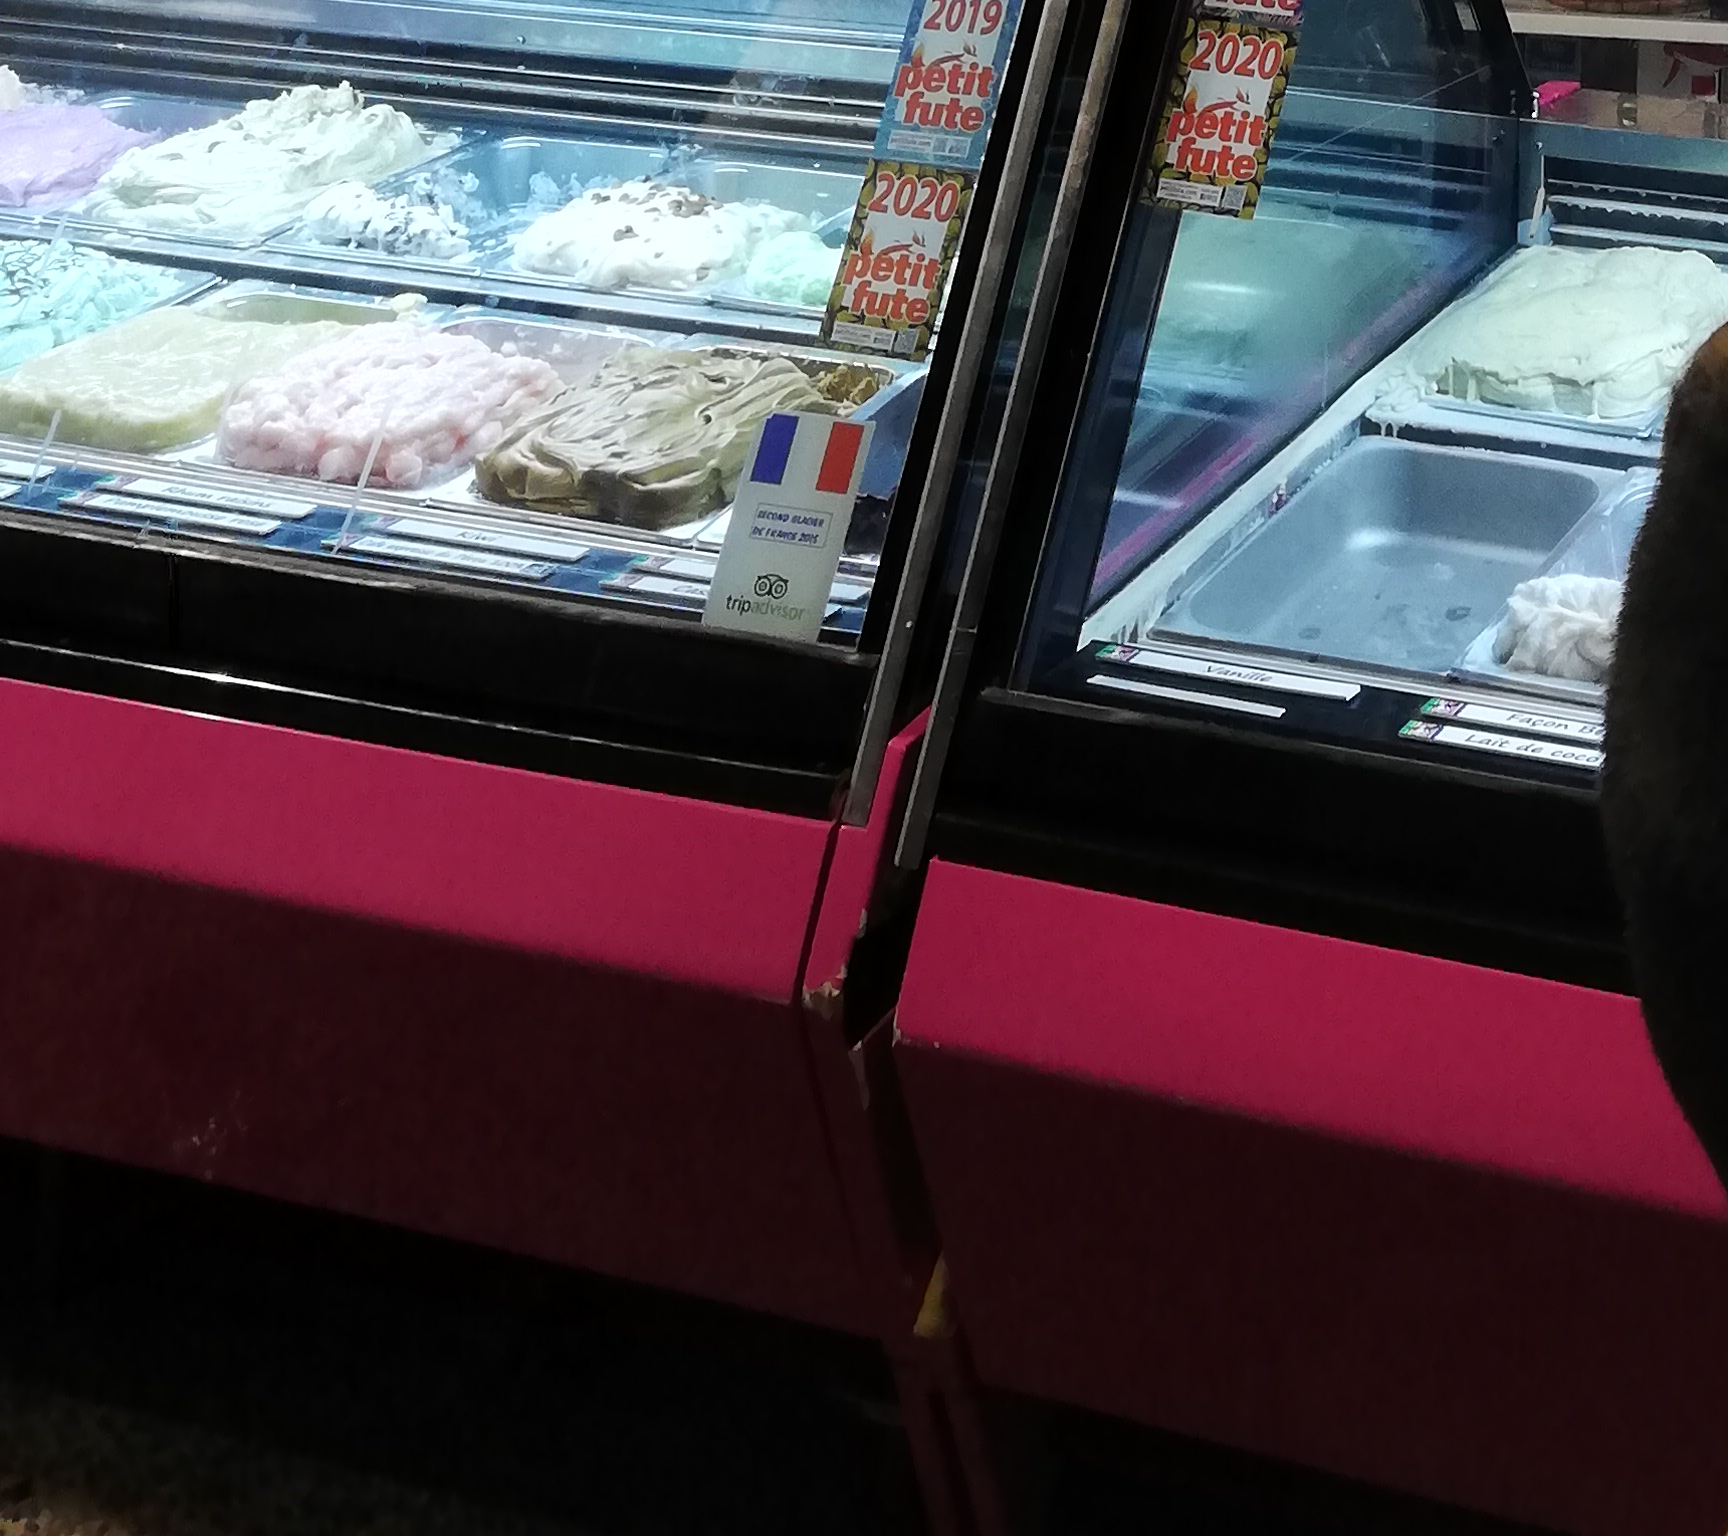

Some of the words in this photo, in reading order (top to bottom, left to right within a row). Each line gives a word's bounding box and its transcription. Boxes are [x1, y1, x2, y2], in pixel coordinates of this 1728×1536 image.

[1189, 31, 1283, 79] 2020
[894, 63, 994, 98] petit
[1166, 108, 1266, 148] petit
[868, 172, 958, 223] 2020
[843, 251, 940, 290] petit
[726, 595, 804, 620] tripadvisor
[1203, 666, 1273, 682] Vanille
[1506, 713, 1568, 731] Façon
[1465, 734, 1511, 748] Lait
[1516, 743, 1544, 754] de
[1551, 750, 1599, 763] coco
